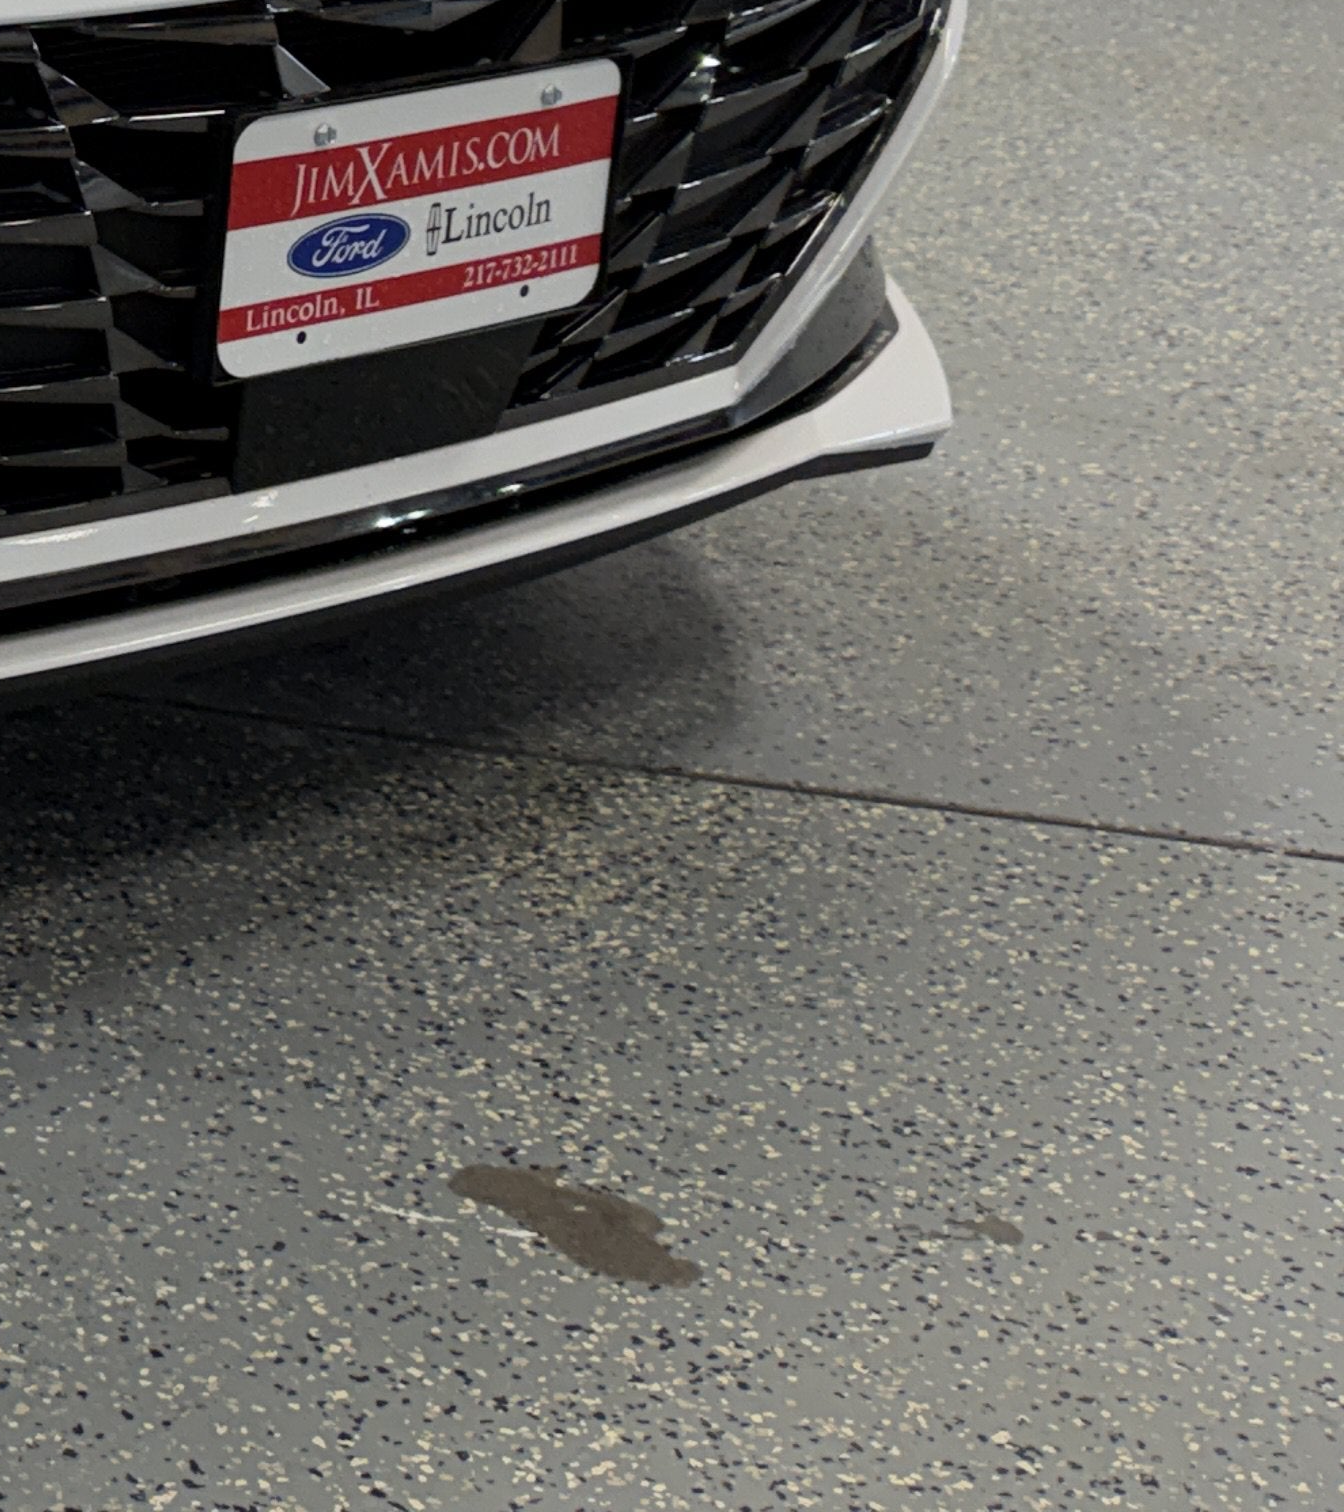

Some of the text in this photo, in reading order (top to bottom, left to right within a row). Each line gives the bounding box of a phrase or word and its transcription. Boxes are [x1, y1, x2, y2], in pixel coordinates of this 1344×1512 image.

[291, 124, 560, 217] JIMXAMIS.COM
[440, 192, 552, 244] Lincoln
[311, 223, 387, 267] Ford
[463, 243, 578, 289] 217-732-2111
[245, 287, 380, 332] Lincoln, IL
